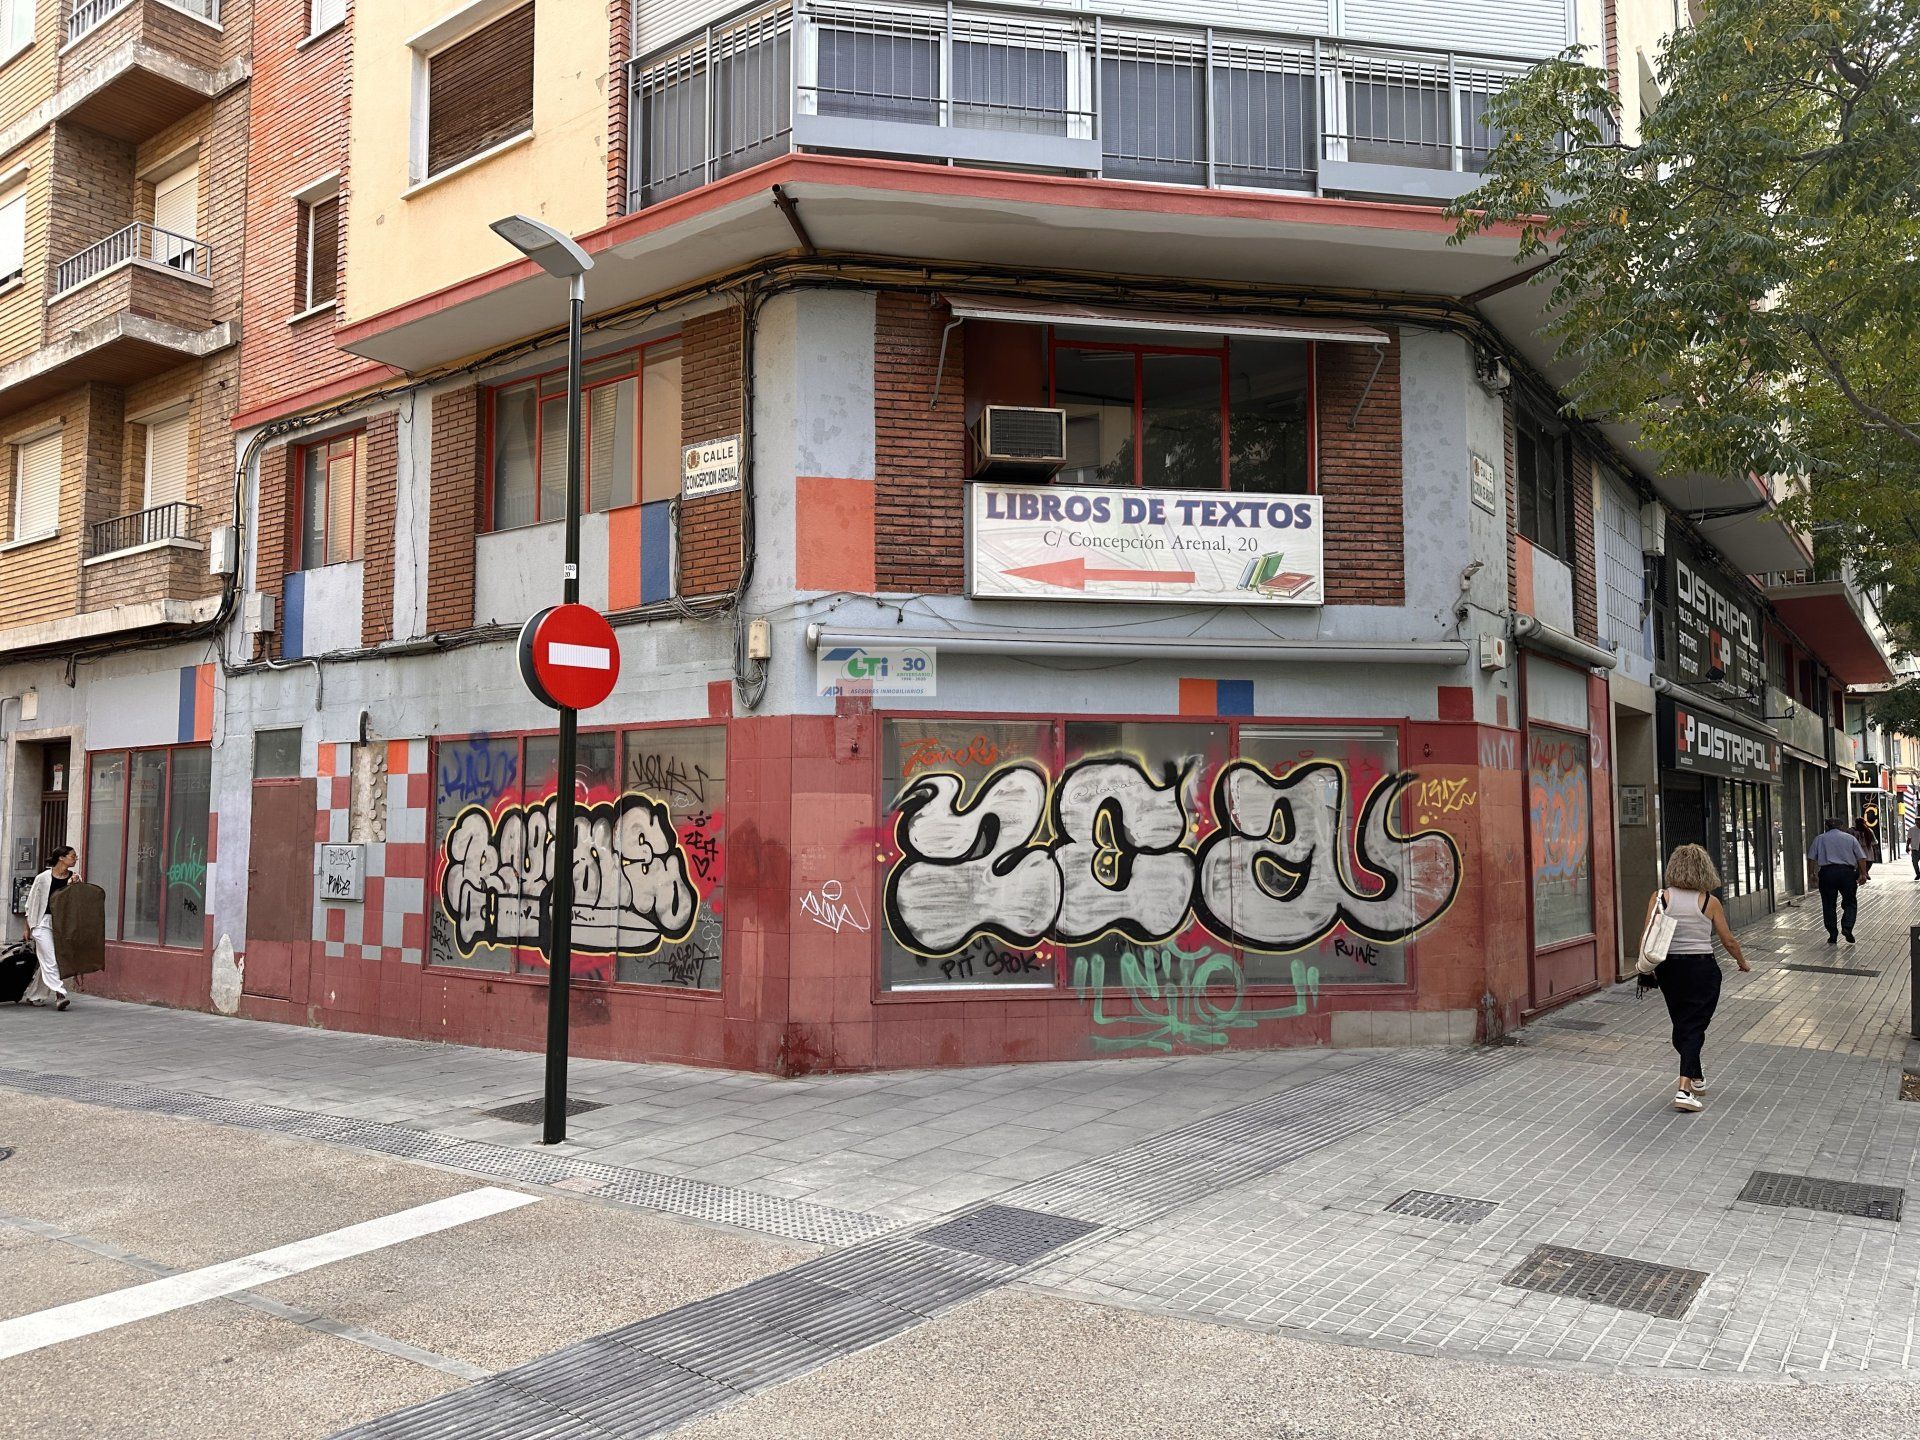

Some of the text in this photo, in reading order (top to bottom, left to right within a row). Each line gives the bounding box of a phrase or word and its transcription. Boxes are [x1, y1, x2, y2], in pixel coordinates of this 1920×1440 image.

[703, 446, 733, 463] CALLE
[985, 491, 1312, 530] LIBROS DE TEXTOS
[1043, 530, 1258, 555] C/ Concepción Arenal, 20
[1676, 558, 1759, 653] DISTRIPOL
[1697, 721, 1771, 772] DISTRIPOL
[940, 954, 976, 980] PIT
